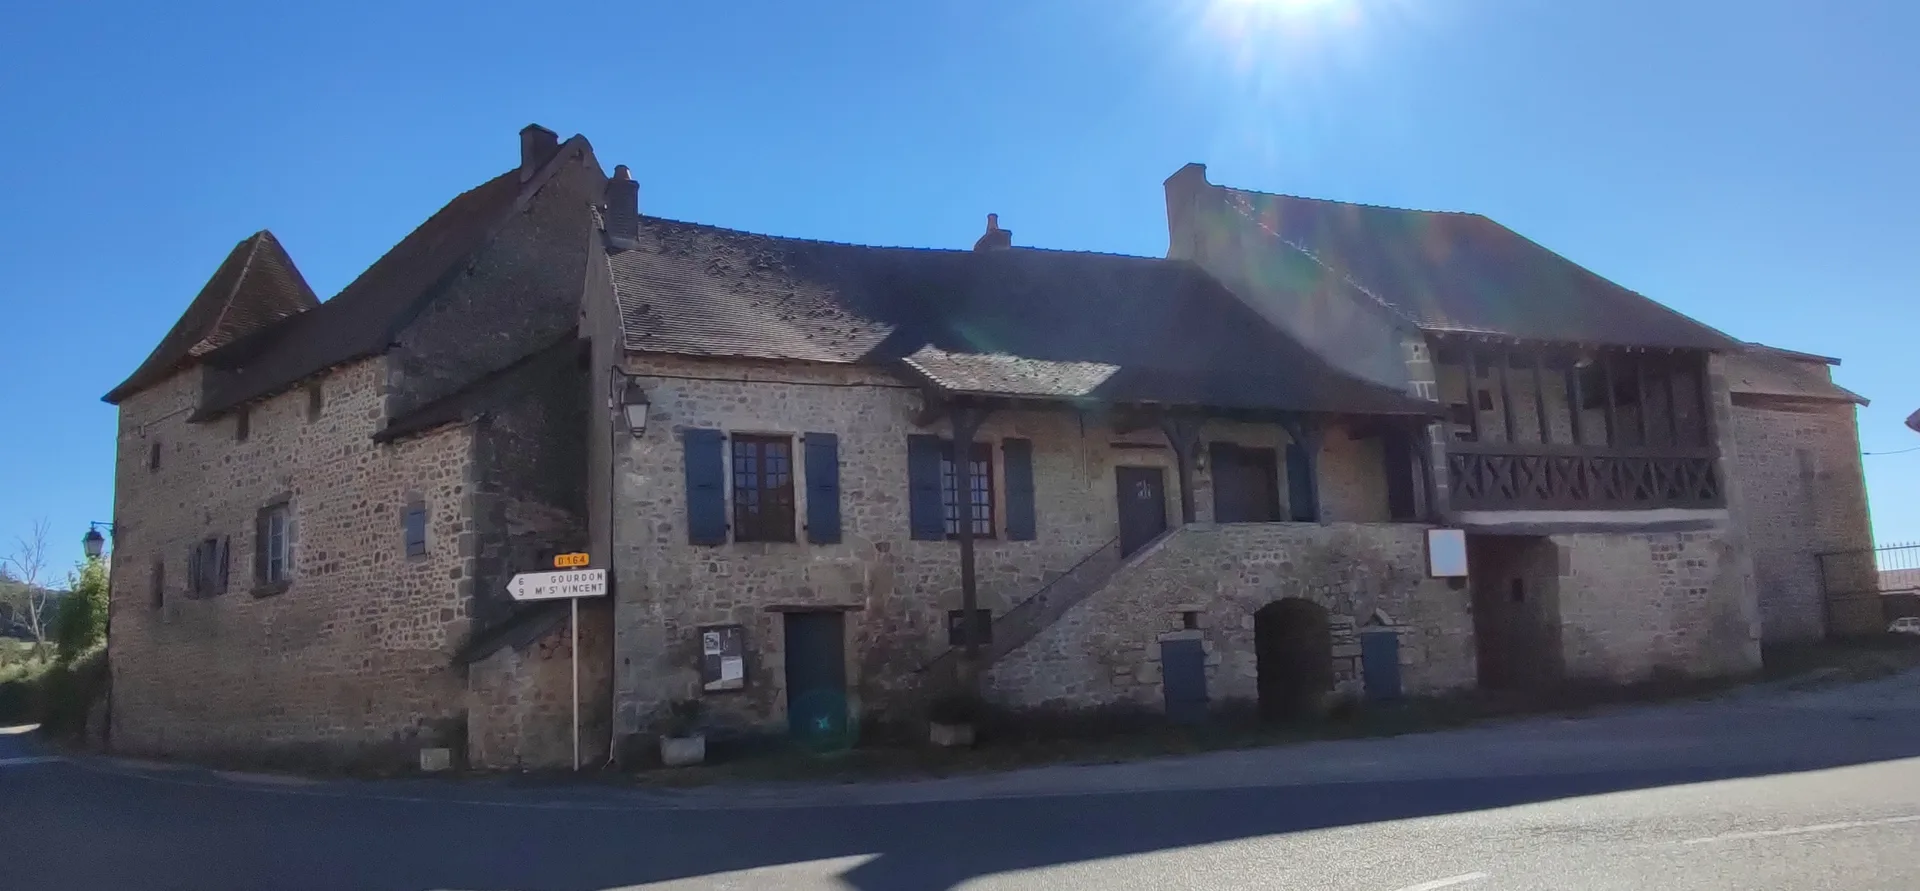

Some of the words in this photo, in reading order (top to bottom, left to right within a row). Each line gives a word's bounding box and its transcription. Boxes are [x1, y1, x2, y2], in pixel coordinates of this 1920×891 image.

[518, 577, 525, 586] 6
[550, 572, 603, 584] GOURDON
[518, 587, 525, 596] 9
[562, 583, 603, 593] VINCENT
